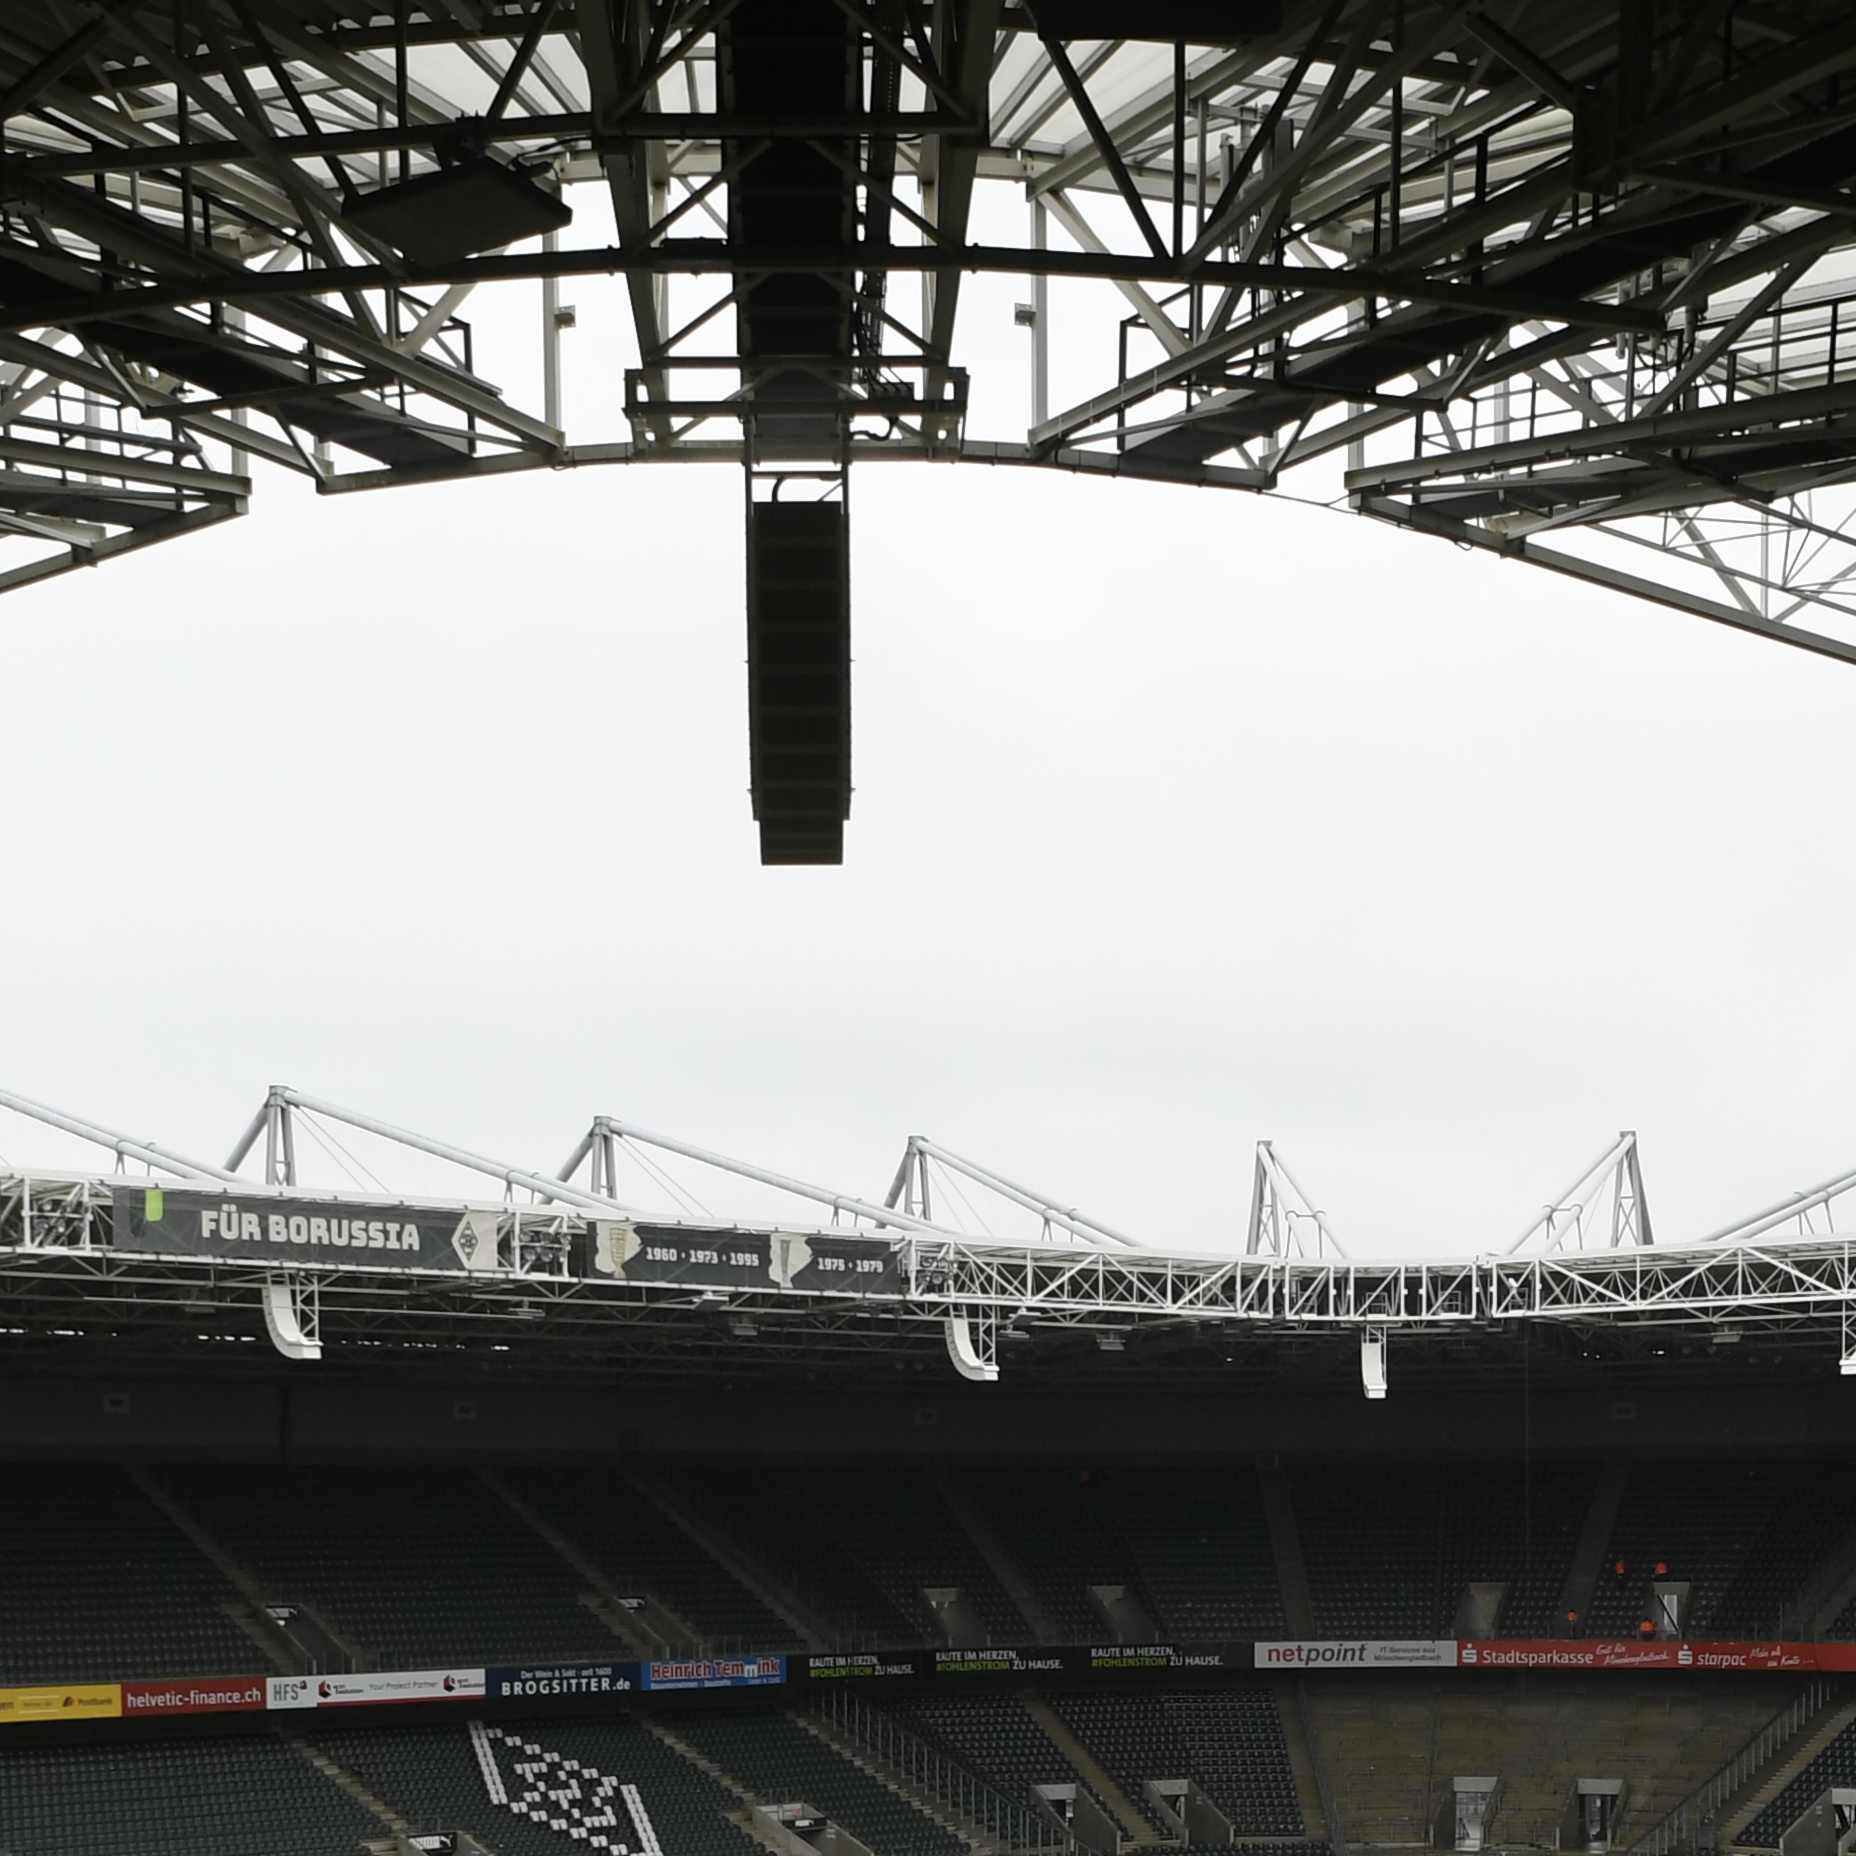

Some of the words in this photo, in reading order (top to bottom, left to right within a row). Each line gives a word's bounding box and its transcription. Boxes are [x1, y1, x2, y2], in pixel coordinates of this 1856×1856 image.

[201, 1203, 262, 1241] FÜR
[268, 1214, 421, 1251] BORUSSIA
[1267, 1644, 1366, 1666] netpoint
[1482, 1648, 1594, 1667] Stadtsparkasse
[651, 1660, 713, 1681] Heinrich
[500, 1676, 632, 1697] BROGSITTER.de
[126, 1688, 262, 1710] helvetic-finance.ch
